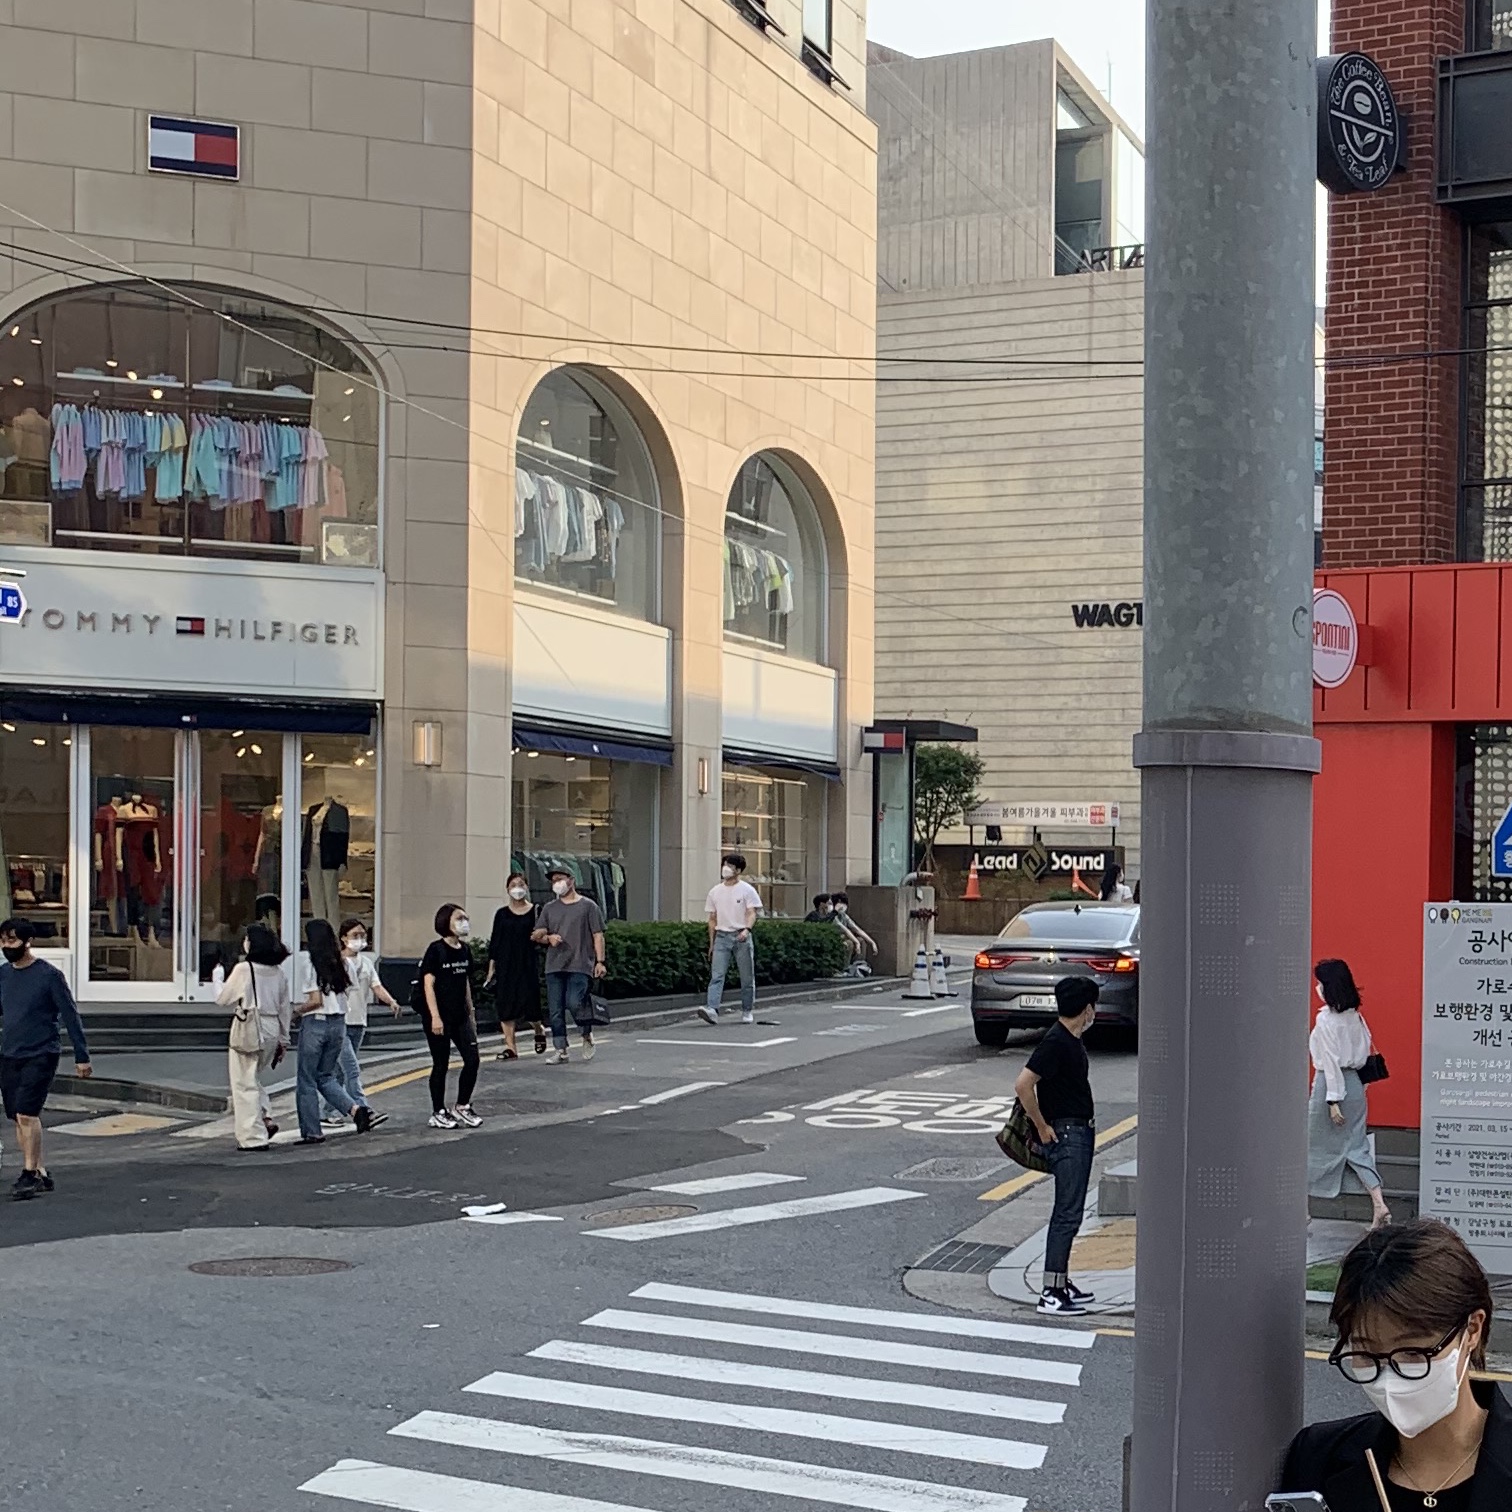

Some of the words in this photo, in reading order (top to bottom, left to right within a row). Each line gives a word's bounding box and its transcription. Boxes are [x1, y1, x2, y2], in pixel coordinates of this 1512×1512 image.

[1330, 77, 1345, 105] The
[1341, 60, 1373, 80] Coffee
[1346, 154, 1364, 180] Tea
[1364, 152, 1389, 183] Leaf
[6, 595, 19, 609] 85
[214, 617, 361, 646] HILFIGER
[1002, 806, 1057, 819] 봄여름가을겨울
[1060, 806, 1084, 819] 피부과
[973, 852, 1018, 870] Lead
[1051, 852, 1105, 871] Sound
[1459, 956, 1508, 966] Construction
[1433, 1002, 1494, 1022] 보행환경
[1472, 1028, 1502, 1048] 개선
[1455, 1057, 1478, 1069] 공사는
[1480, 1059, 1511, 1070] 가로수길
[1435, 1122, 1462, 1132] 공사기간
